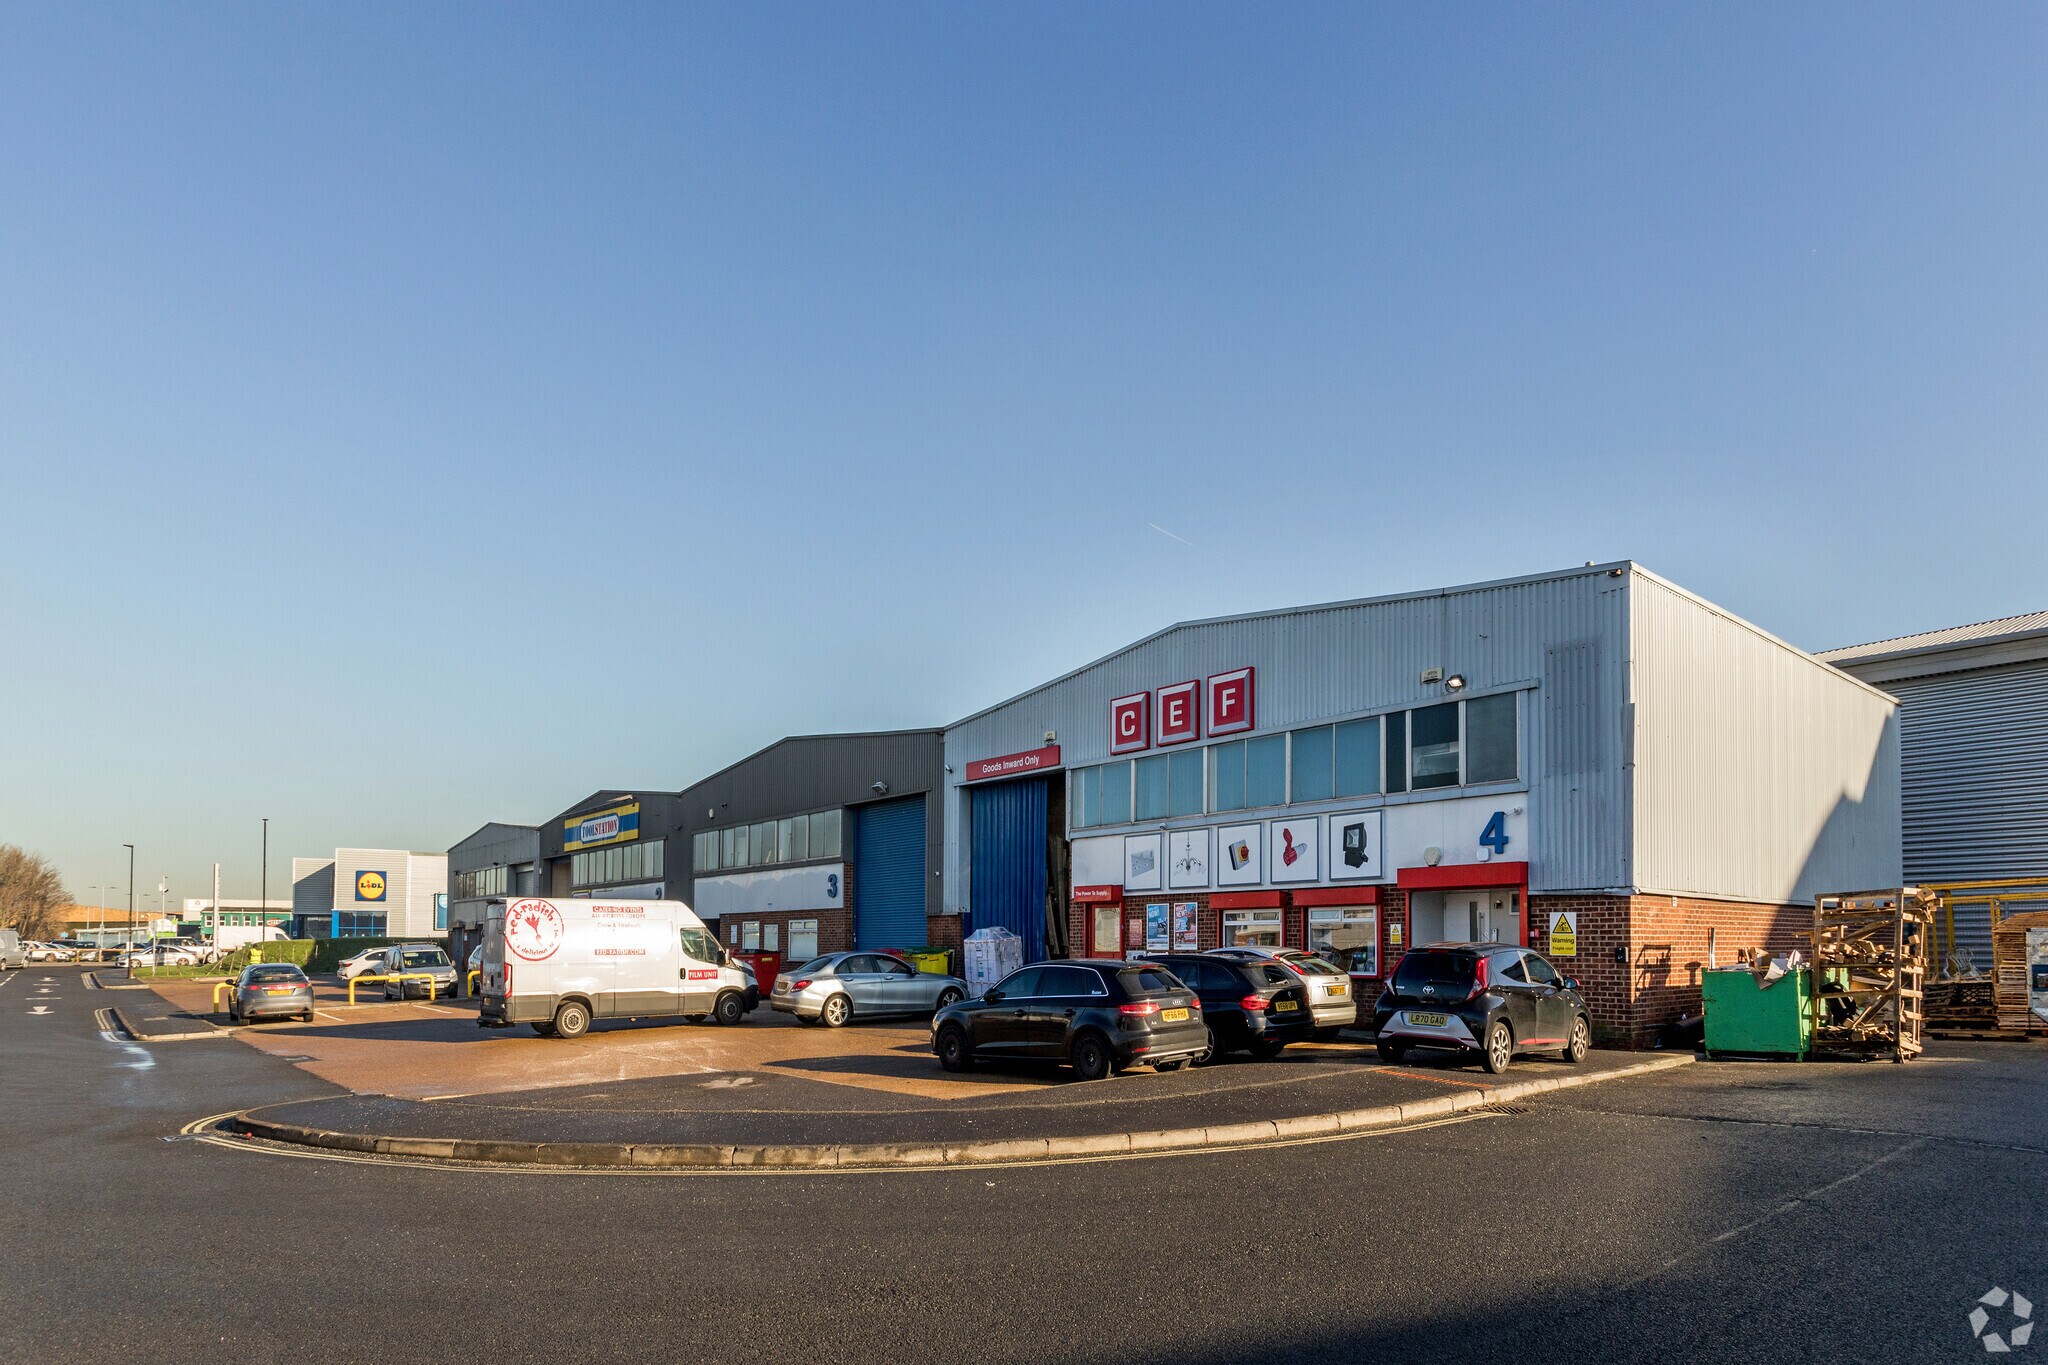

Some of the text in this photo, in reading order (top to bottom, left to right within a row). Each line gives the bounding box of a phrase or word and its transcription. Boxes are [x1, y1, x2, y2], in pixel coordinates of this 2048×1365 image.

[982, 755, 1039, 773] Goods Inward Only
[582, 819, 617, 838] TOOLSTATION
[1479, 811, 1509, 854] 4
[827, 874, 838, 898] 3
[1551, 937, 1575, 945] Warning
[690, 971, 702, 979] FILM
[1410, 1014, 1429, 1023] LR70
